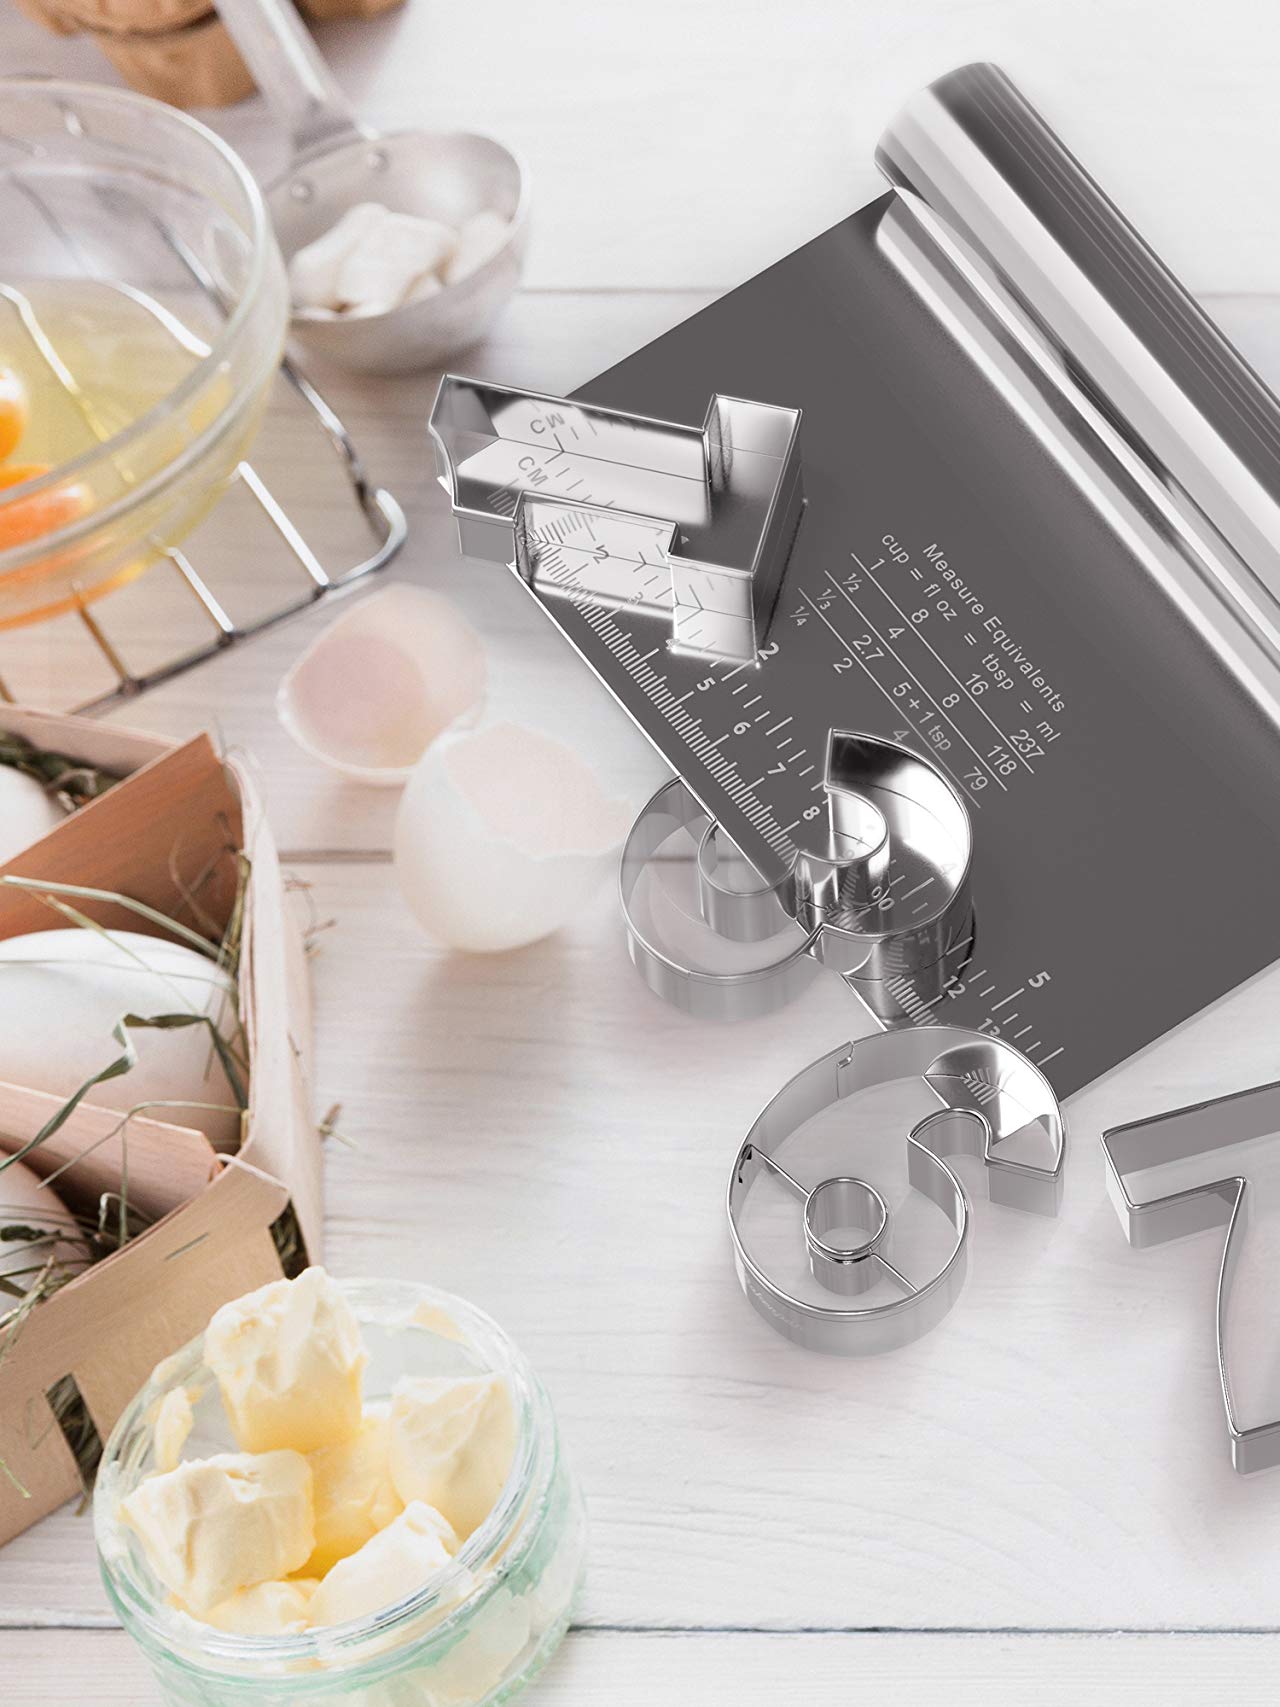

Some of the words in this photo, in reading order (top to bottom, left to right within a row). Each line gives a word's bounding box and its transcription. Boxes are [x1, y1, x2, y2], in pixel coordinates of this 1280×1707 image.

[518, 456, 549, 486] CM
[881, 534, 910, 564] cup
[923, 583, 942, 598] fl
[936, 600, 958, 622] oz
[981, 653, 1015, 690] tbsp
[1035, 721, 1062, 743] ml
[922, 543, 985, 615] Measure
[983, 615, 1065, 712] Equivalents
[760, 641, 781, 662] 2
[870, 558, 886, 571] 1
[911, 608, 930, 624] 8
[965, 673, 990, 696] 16
[1009, 729, 1046, 759] 237
[832, 657, 853, 674] 2
[696, 676, 717, 692] 5
[852, 634, 885, 660] 2.7
[892, 681, 912, 697] 5
[919, 711, 935, 724] 1
[927, 724, 952, 751] tsp
[963, 766, 989, 791] 79
[888, 627, 906, 640] 4
[942, 693, 960, 709] 8
[987, 745, 1018, 776] 118
[732, 720, 752, 736] 6
[768, 762, 787, 777] 7
[802, 805, 821, 821] 8
[942, 975, 967, 1000] 12
[1027, 970, 1052, 989] 5
